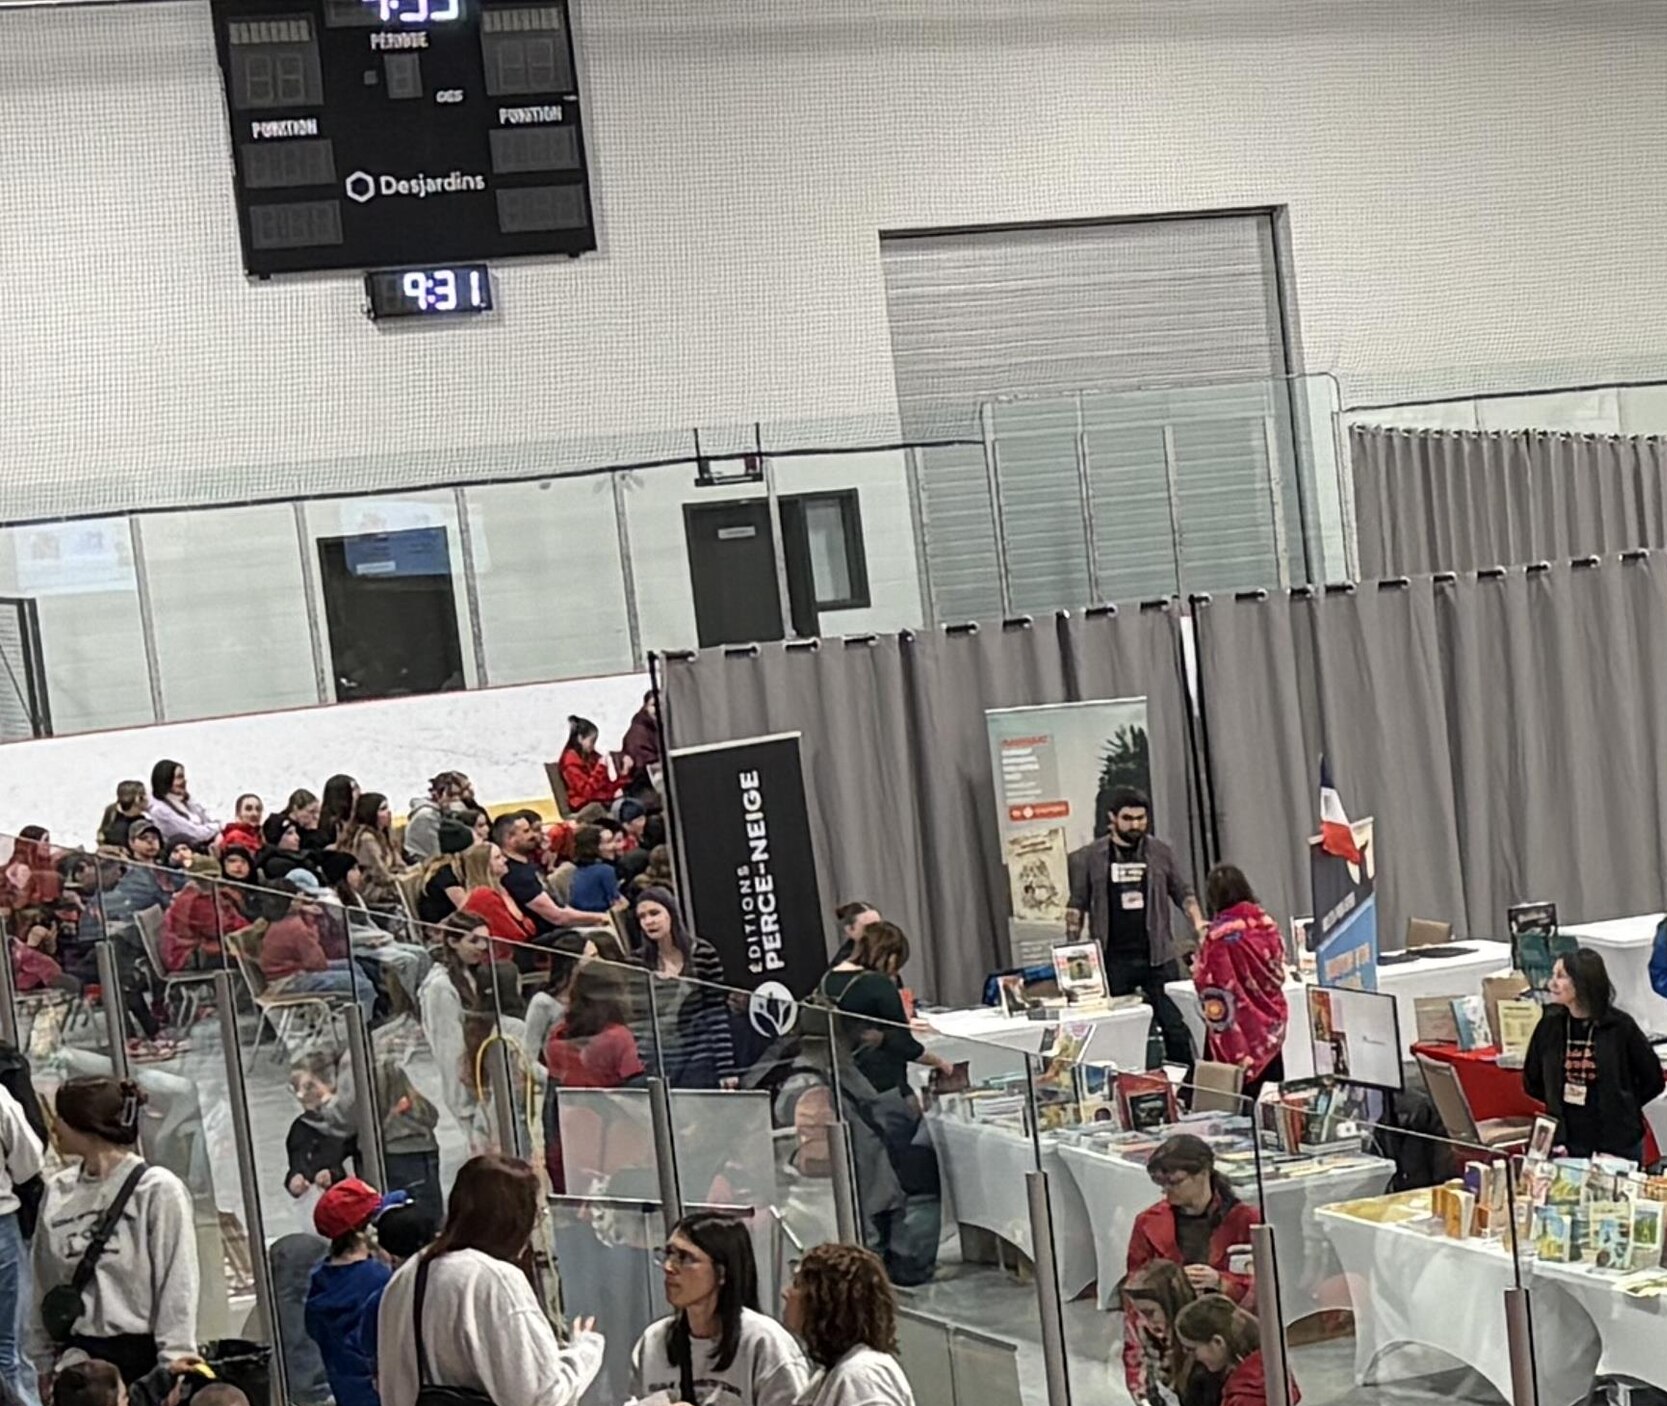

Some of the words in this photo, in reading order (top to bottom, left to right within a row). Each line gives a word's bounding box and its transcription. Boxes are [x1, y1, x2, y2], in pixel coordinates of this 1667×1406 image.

[380, 171, 486, 197] Desjardins
[402, 270, 480, 311] 9:31
[739, 769, 786, 972] PERCE-NEIGE
